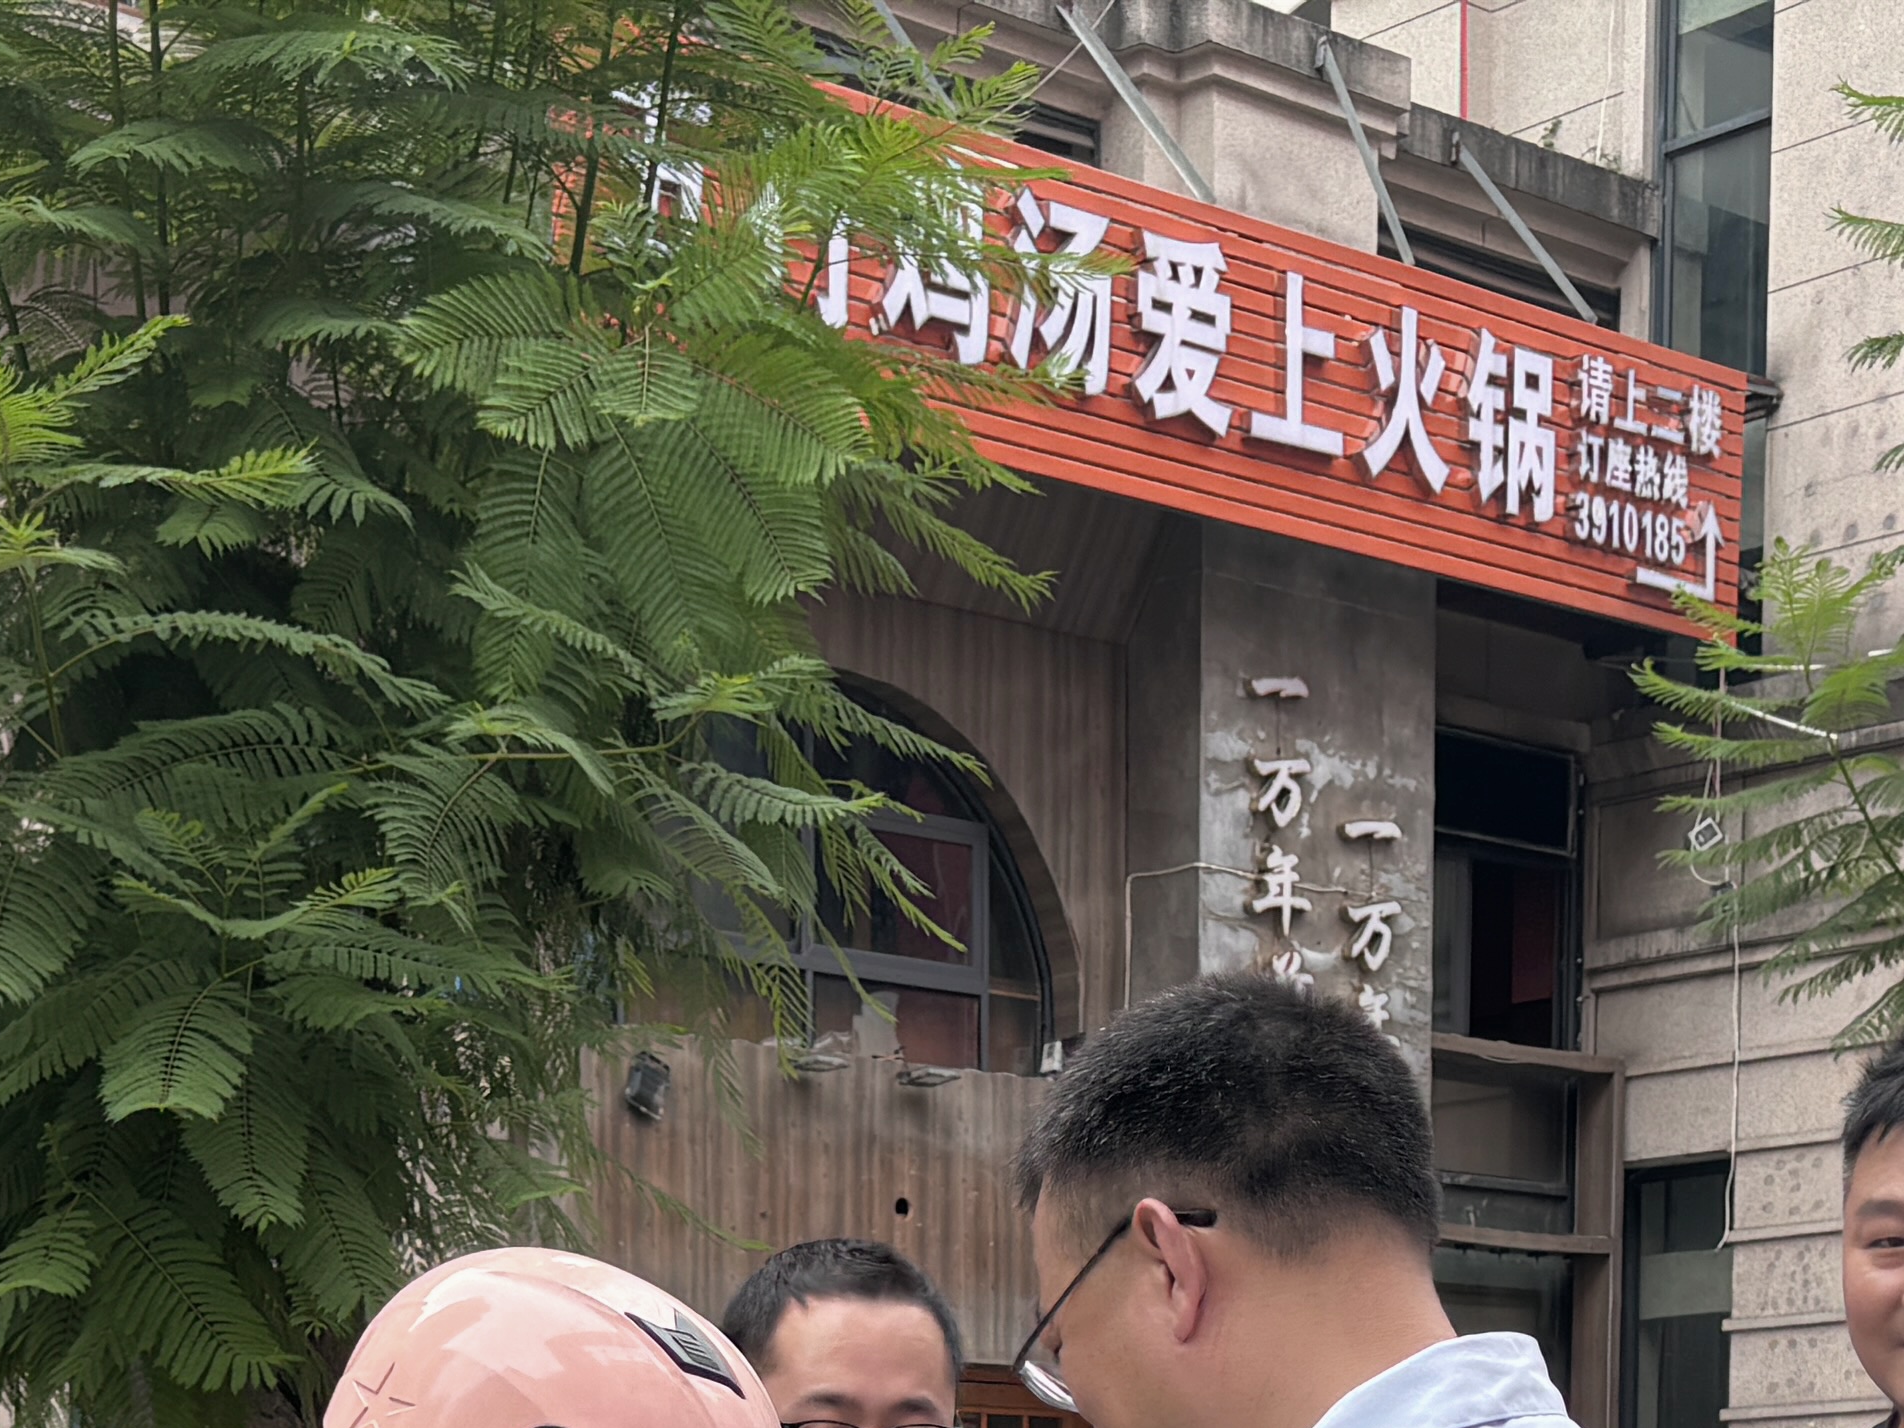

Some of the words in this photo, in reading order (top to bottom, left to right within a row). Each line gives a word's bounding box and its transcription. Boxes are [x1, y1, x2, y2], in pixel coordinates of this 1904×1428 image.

[1577, 353, 1723, 460] 请上二楼
[1576, 428, 1689, 509] 订座热线
[1574, 491, 1686, 566] 3910185
